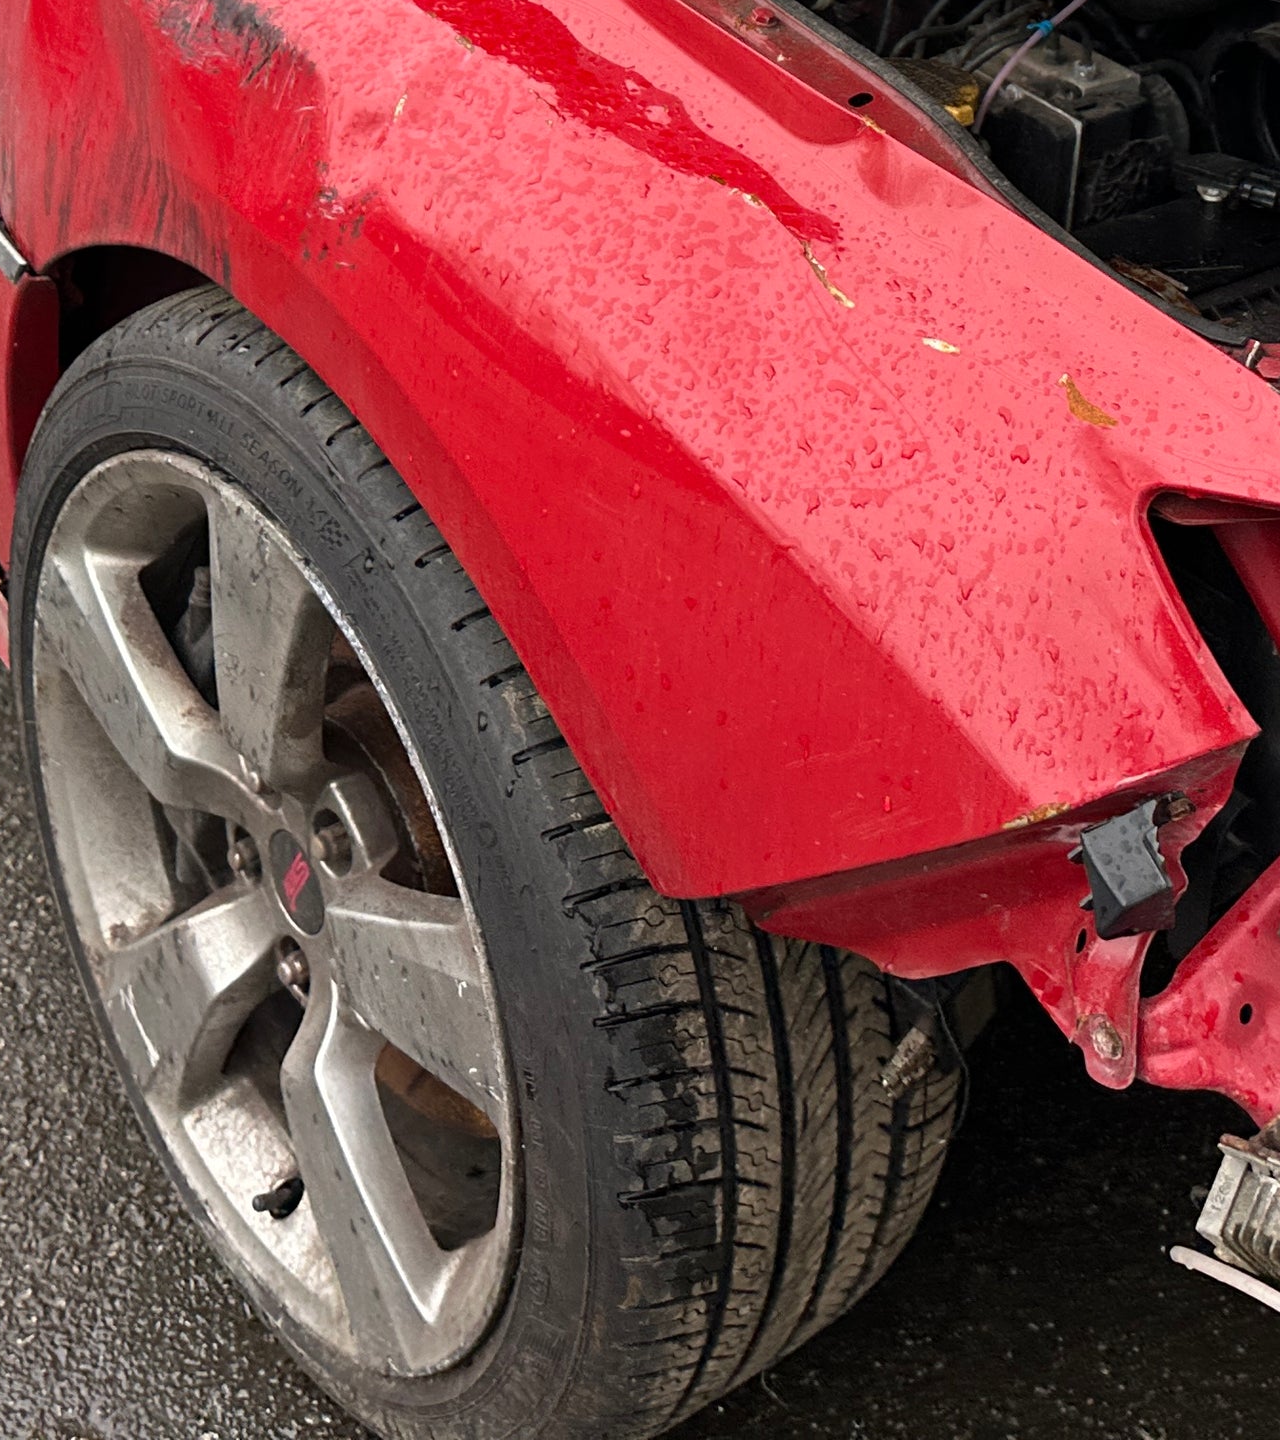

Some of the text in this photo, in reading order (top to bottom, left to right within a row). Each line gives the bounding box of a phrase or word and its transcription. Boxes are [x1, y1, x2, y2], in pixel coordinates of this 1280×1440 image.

[160, 384, 207, 419] SPORT
[208, 408, 235, 439] ALL
[238, 432, 304, 499] SEASON
